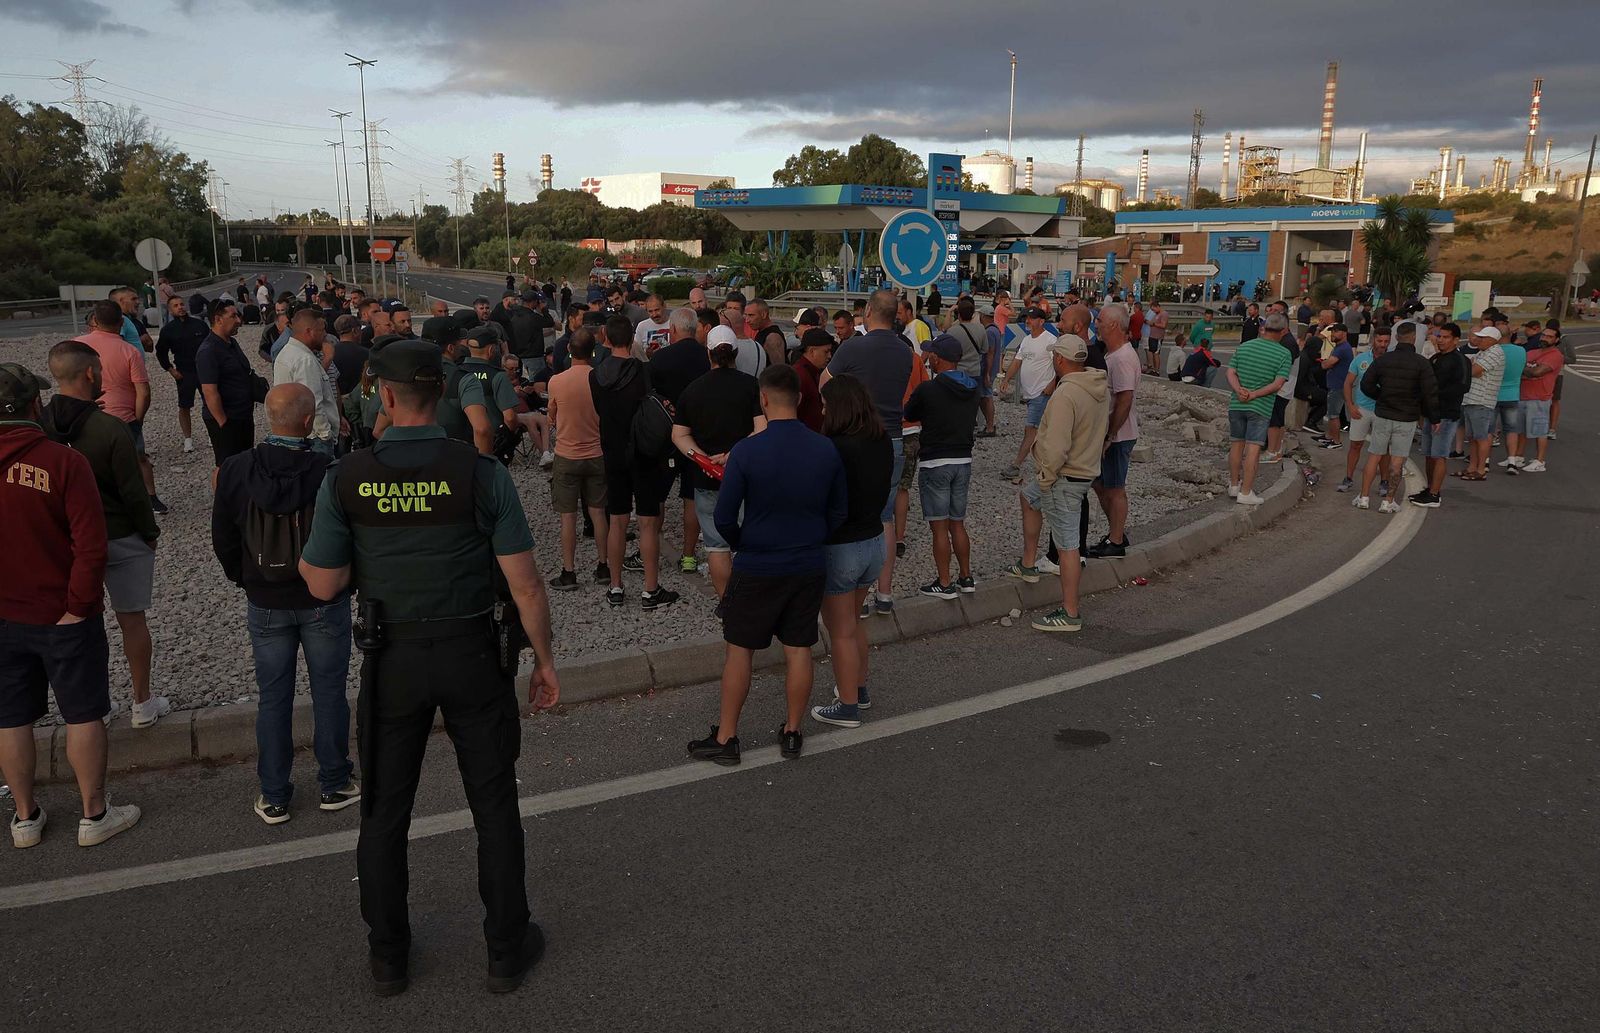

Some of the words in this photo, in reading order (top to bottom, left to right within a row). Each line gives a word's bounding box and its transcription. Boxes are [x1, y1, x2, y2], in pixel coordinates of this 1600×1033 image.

[702, 190, 750, 205] moeve
[861, 187, 914, 205] moeve
[1311, 209, 1341, 217] moeve
[1342, 207, 1366, 216] wash
[358, 481, 452, 497] GUARDIA
[377, 497, 432, 513] CIVIL
